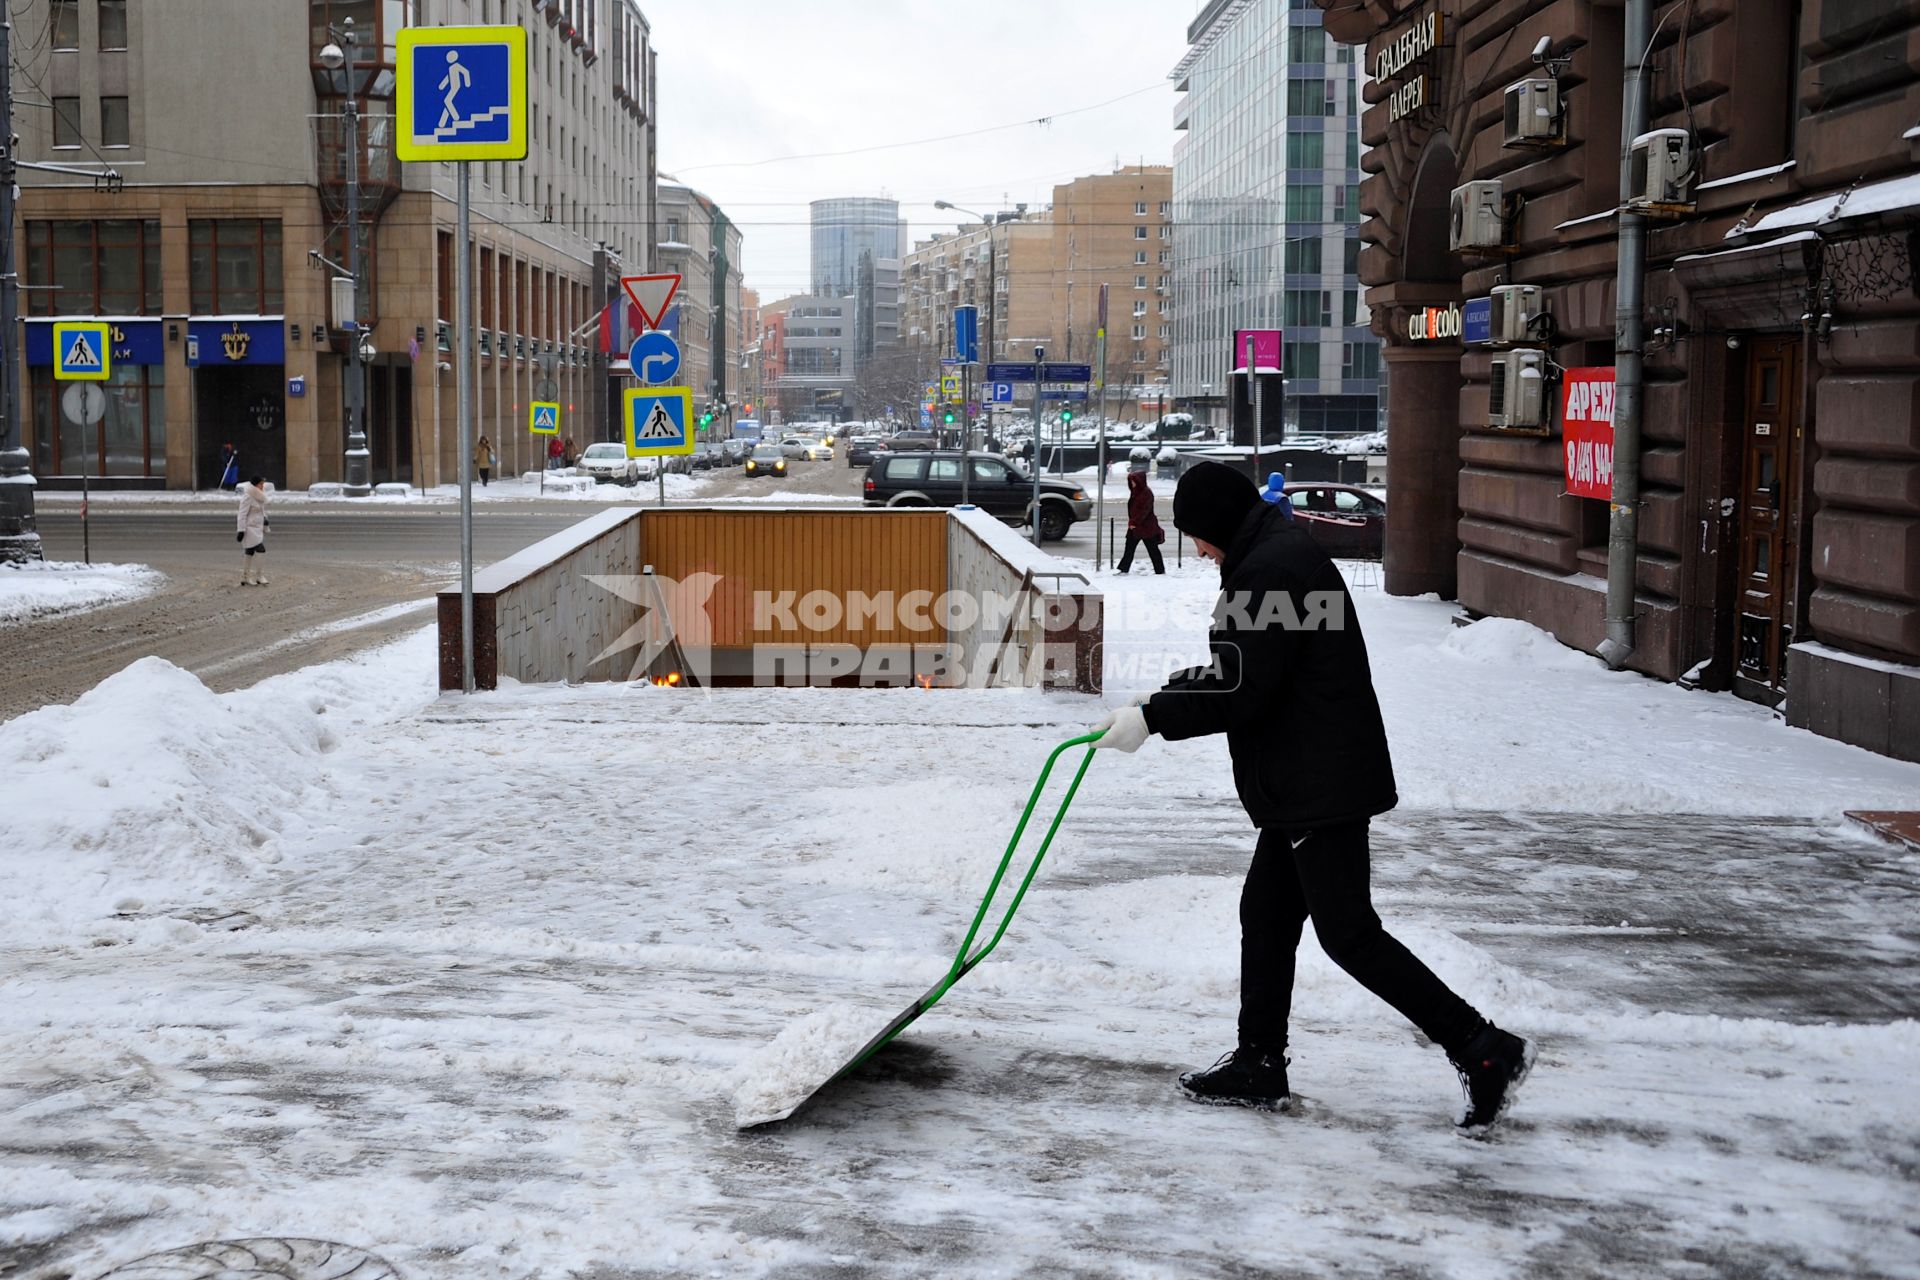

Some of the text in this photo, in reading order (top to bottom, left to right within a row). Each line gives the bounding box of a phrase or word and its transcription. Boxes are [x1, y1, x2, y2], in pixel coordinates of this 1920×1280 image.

[1375, 11, 1435, 85] СВАДЕБНАЯ
[1390, 74, 1423, 123] ГАЛЕРЕЯ
[1409, 307, 1428, 340] cut
[221, 332, 250, 342] ЯКОРЬ
[291, 384, 301, 392] 19
[997, 384, 1009, 400] P
